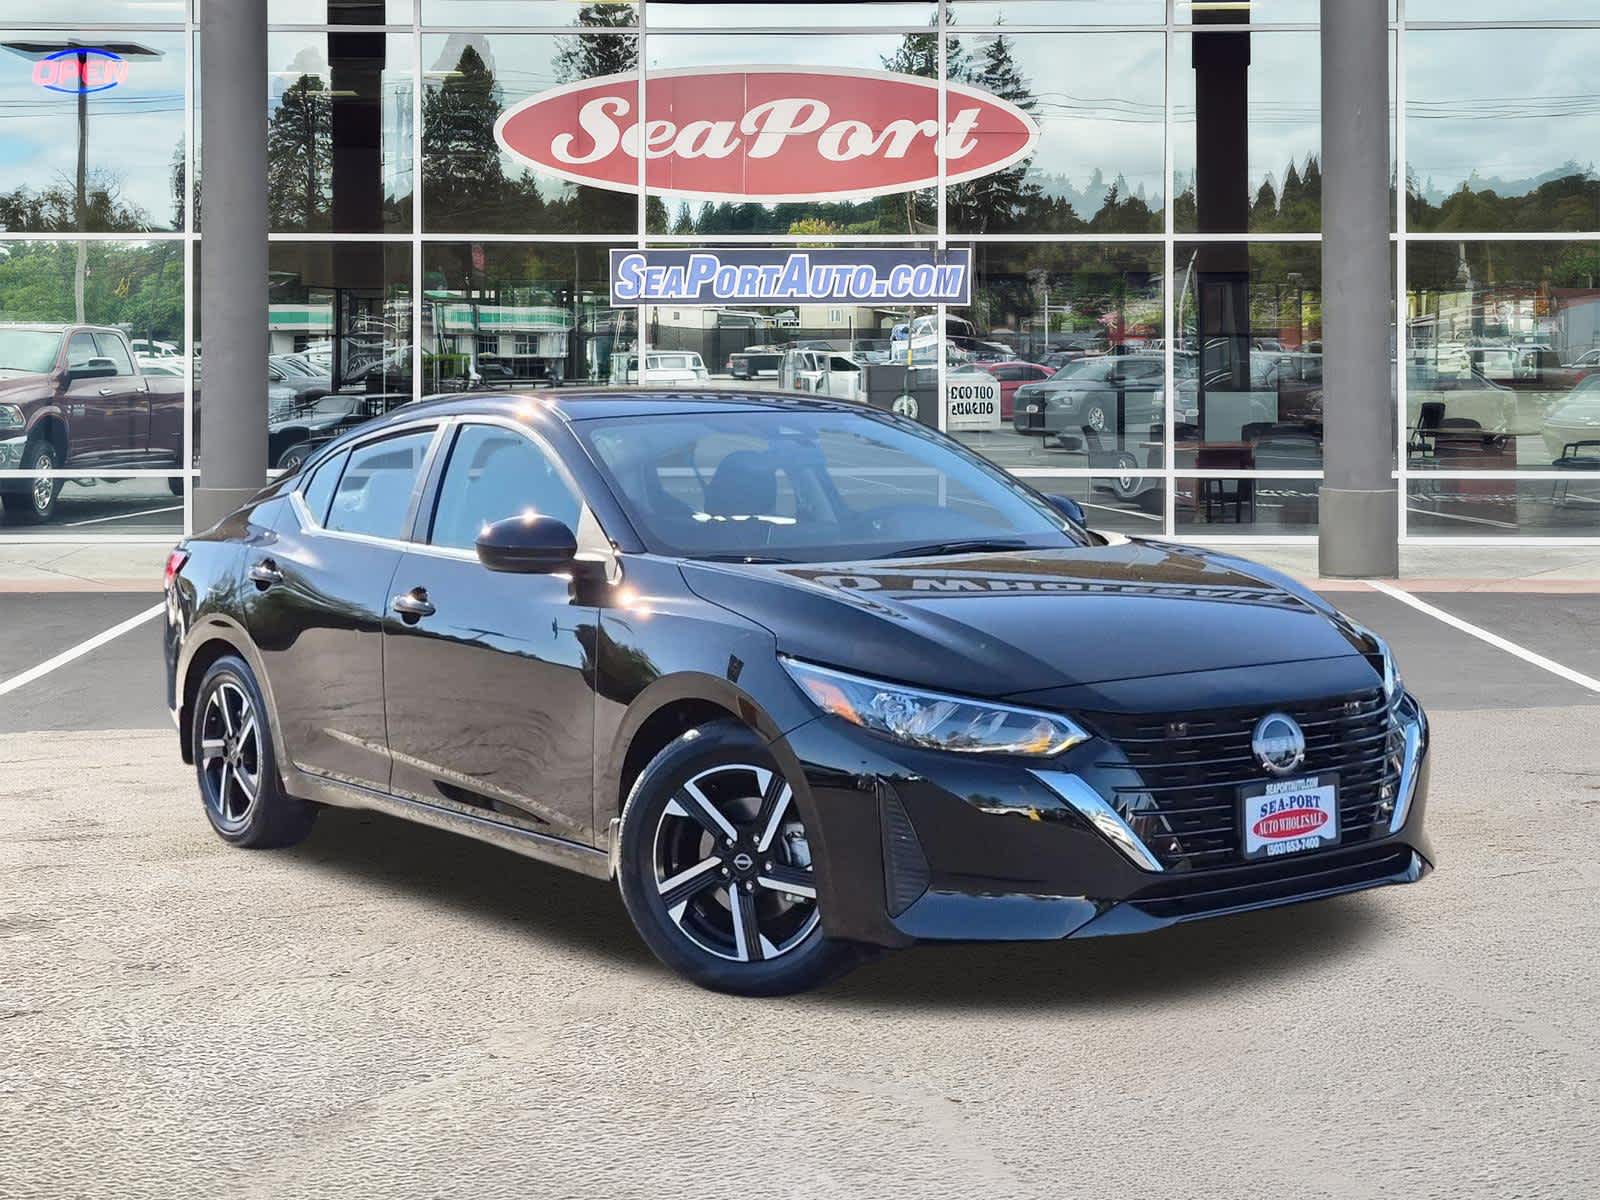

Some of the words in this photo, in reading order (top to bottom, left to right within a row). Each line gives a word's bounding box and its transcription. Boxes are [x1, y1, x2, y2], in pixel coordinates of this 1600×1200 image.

[32, 60, 129, 86] OPEN
[551, 96, 981, 164] SeaPort
[1259, 820, 1279, 836] AUTO
[1279, 811, 1323, 832] WHOLESALE
